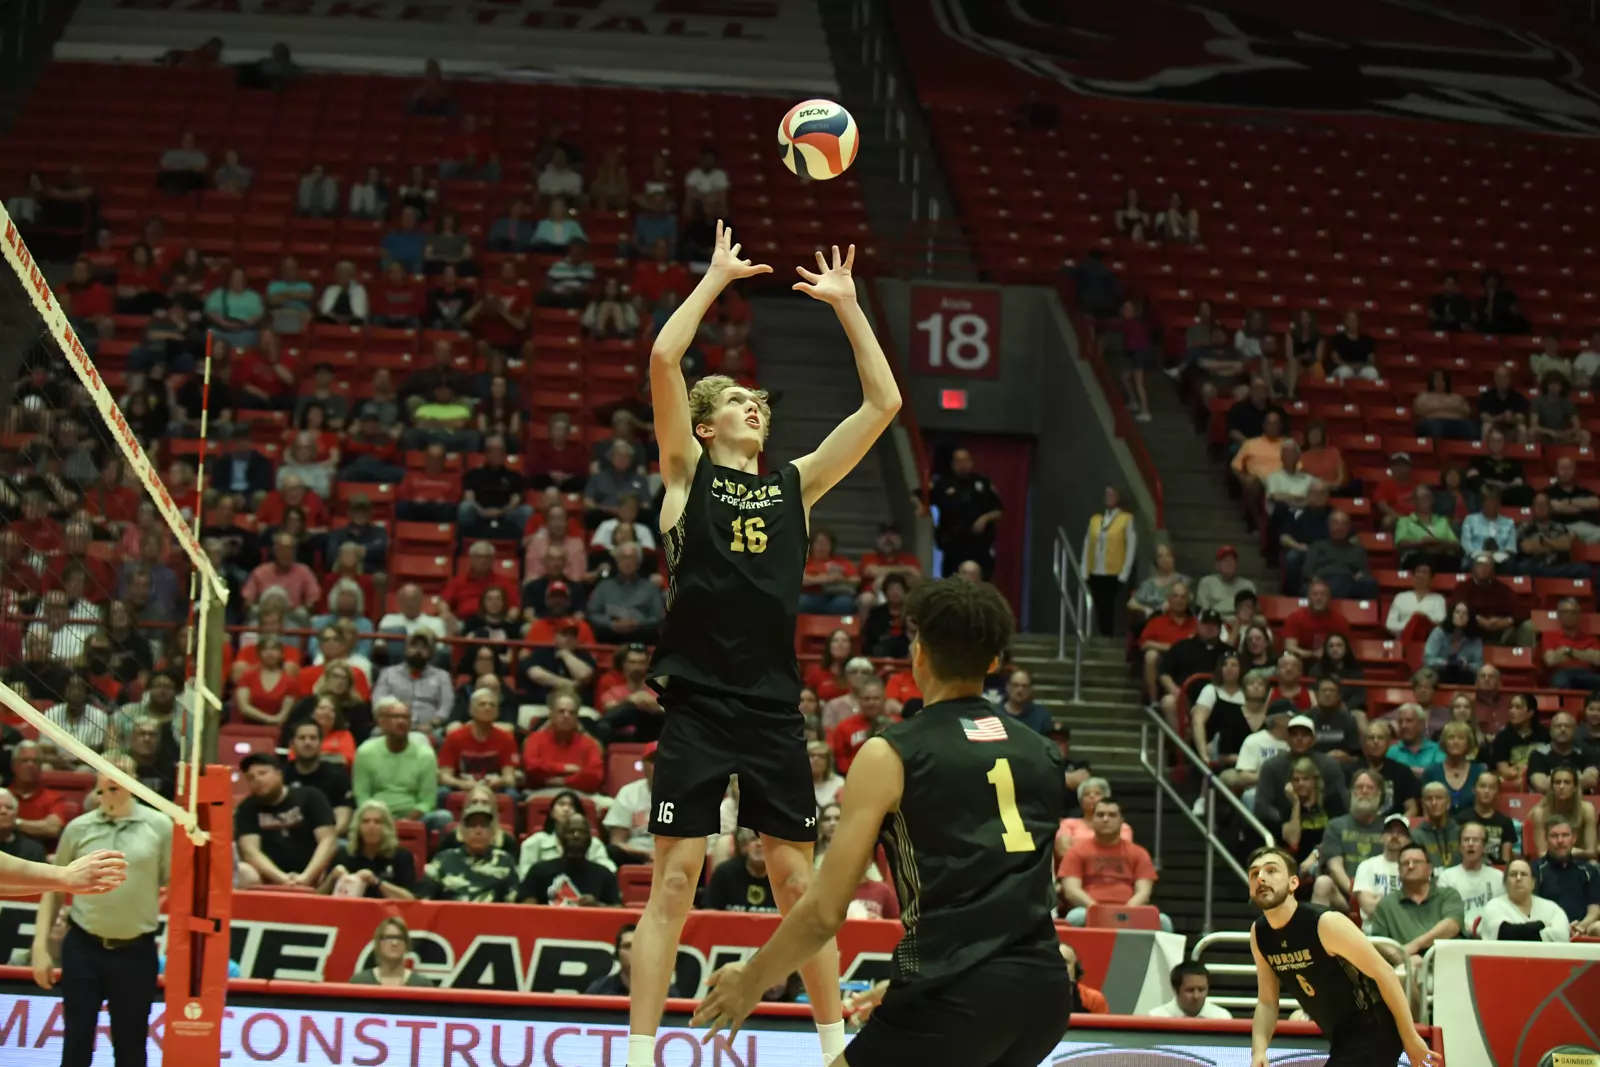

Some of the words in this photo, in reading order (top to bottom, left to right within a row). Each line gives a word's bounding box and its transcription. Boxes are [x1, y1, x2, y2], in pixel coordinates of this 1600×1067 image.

[916, 312, 990, 370] 18
[730, 515, 768, 553] 16
[656, 800, 675, 824] 16
[986, 757, 1036, 853] 1
[1295, 973, 1315, 997] 6
[221, 1008, 757, 1067] ONSTRUCTON
